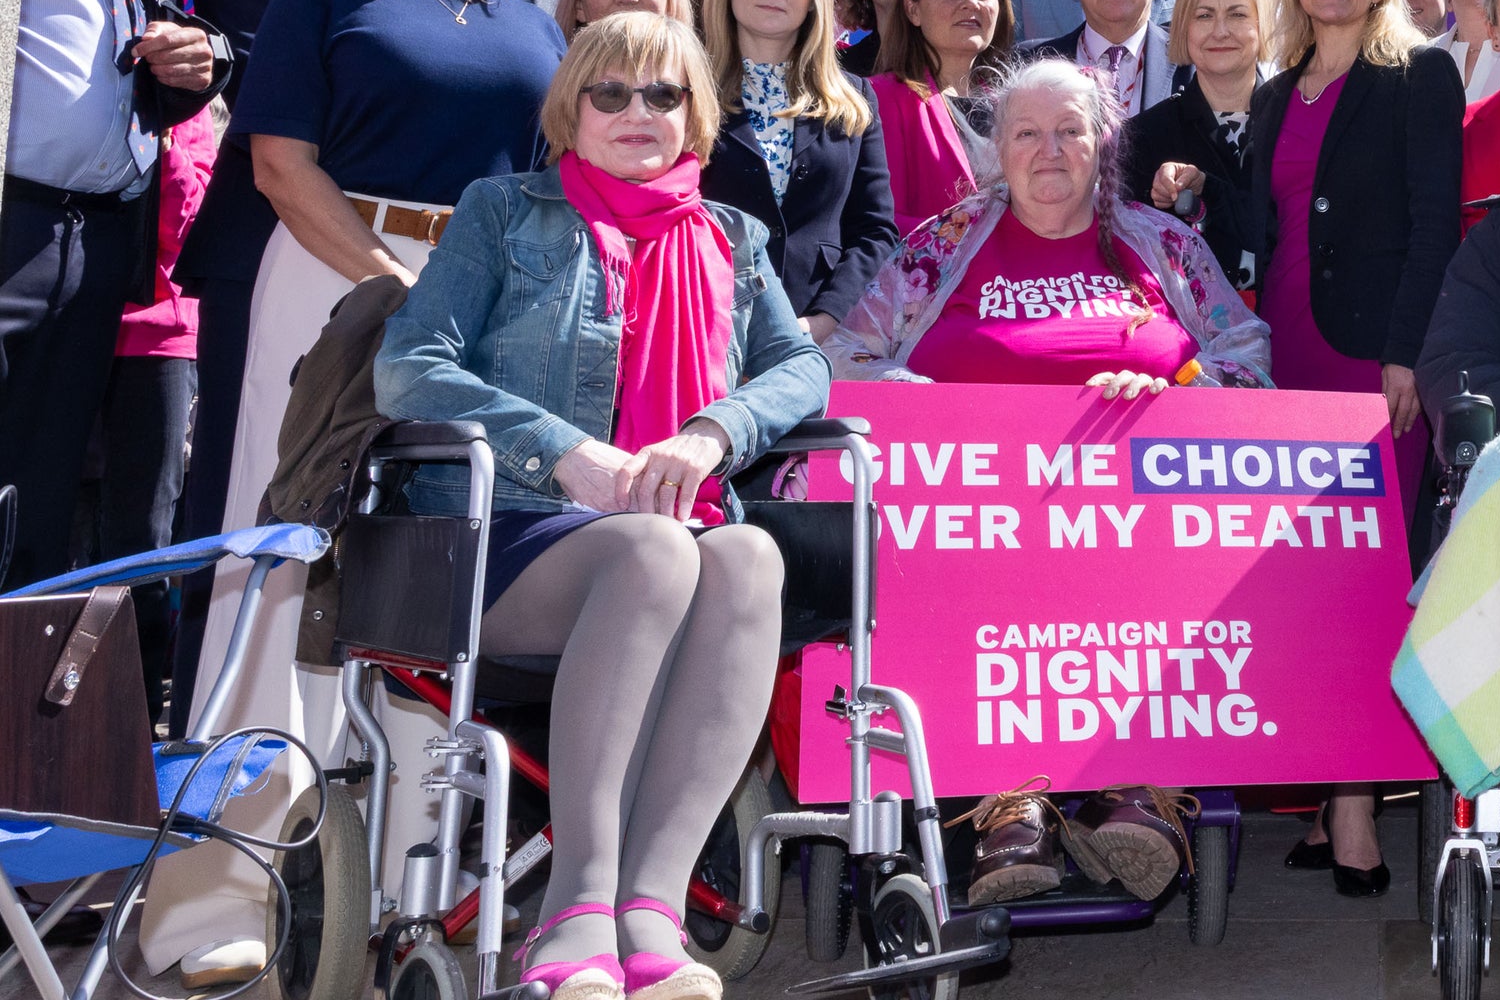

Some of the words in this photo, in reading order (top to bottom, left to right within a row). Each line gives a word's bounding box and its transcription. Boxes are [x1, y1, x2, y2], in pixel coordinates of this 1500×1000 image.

[981, 272, 1085, 296] CAMPAIGN
[1026, 443, 1118, 487] ME
[1141, 444, 1375, 490] CHOICE
[877, 504, 1022, 550] VER
[1049, 504, 1146, 549] MY
[1172, 504, 1382, 549] DEATH
[976, 620, 1168, 649] CAMPAIGN
[1182, 620, 1253, 645] FOR
[976, 646, 1254, 698] DIGNITY
[976, 700, 1043, 745] IN
[1058, 693, 1278, 743] DYING.
